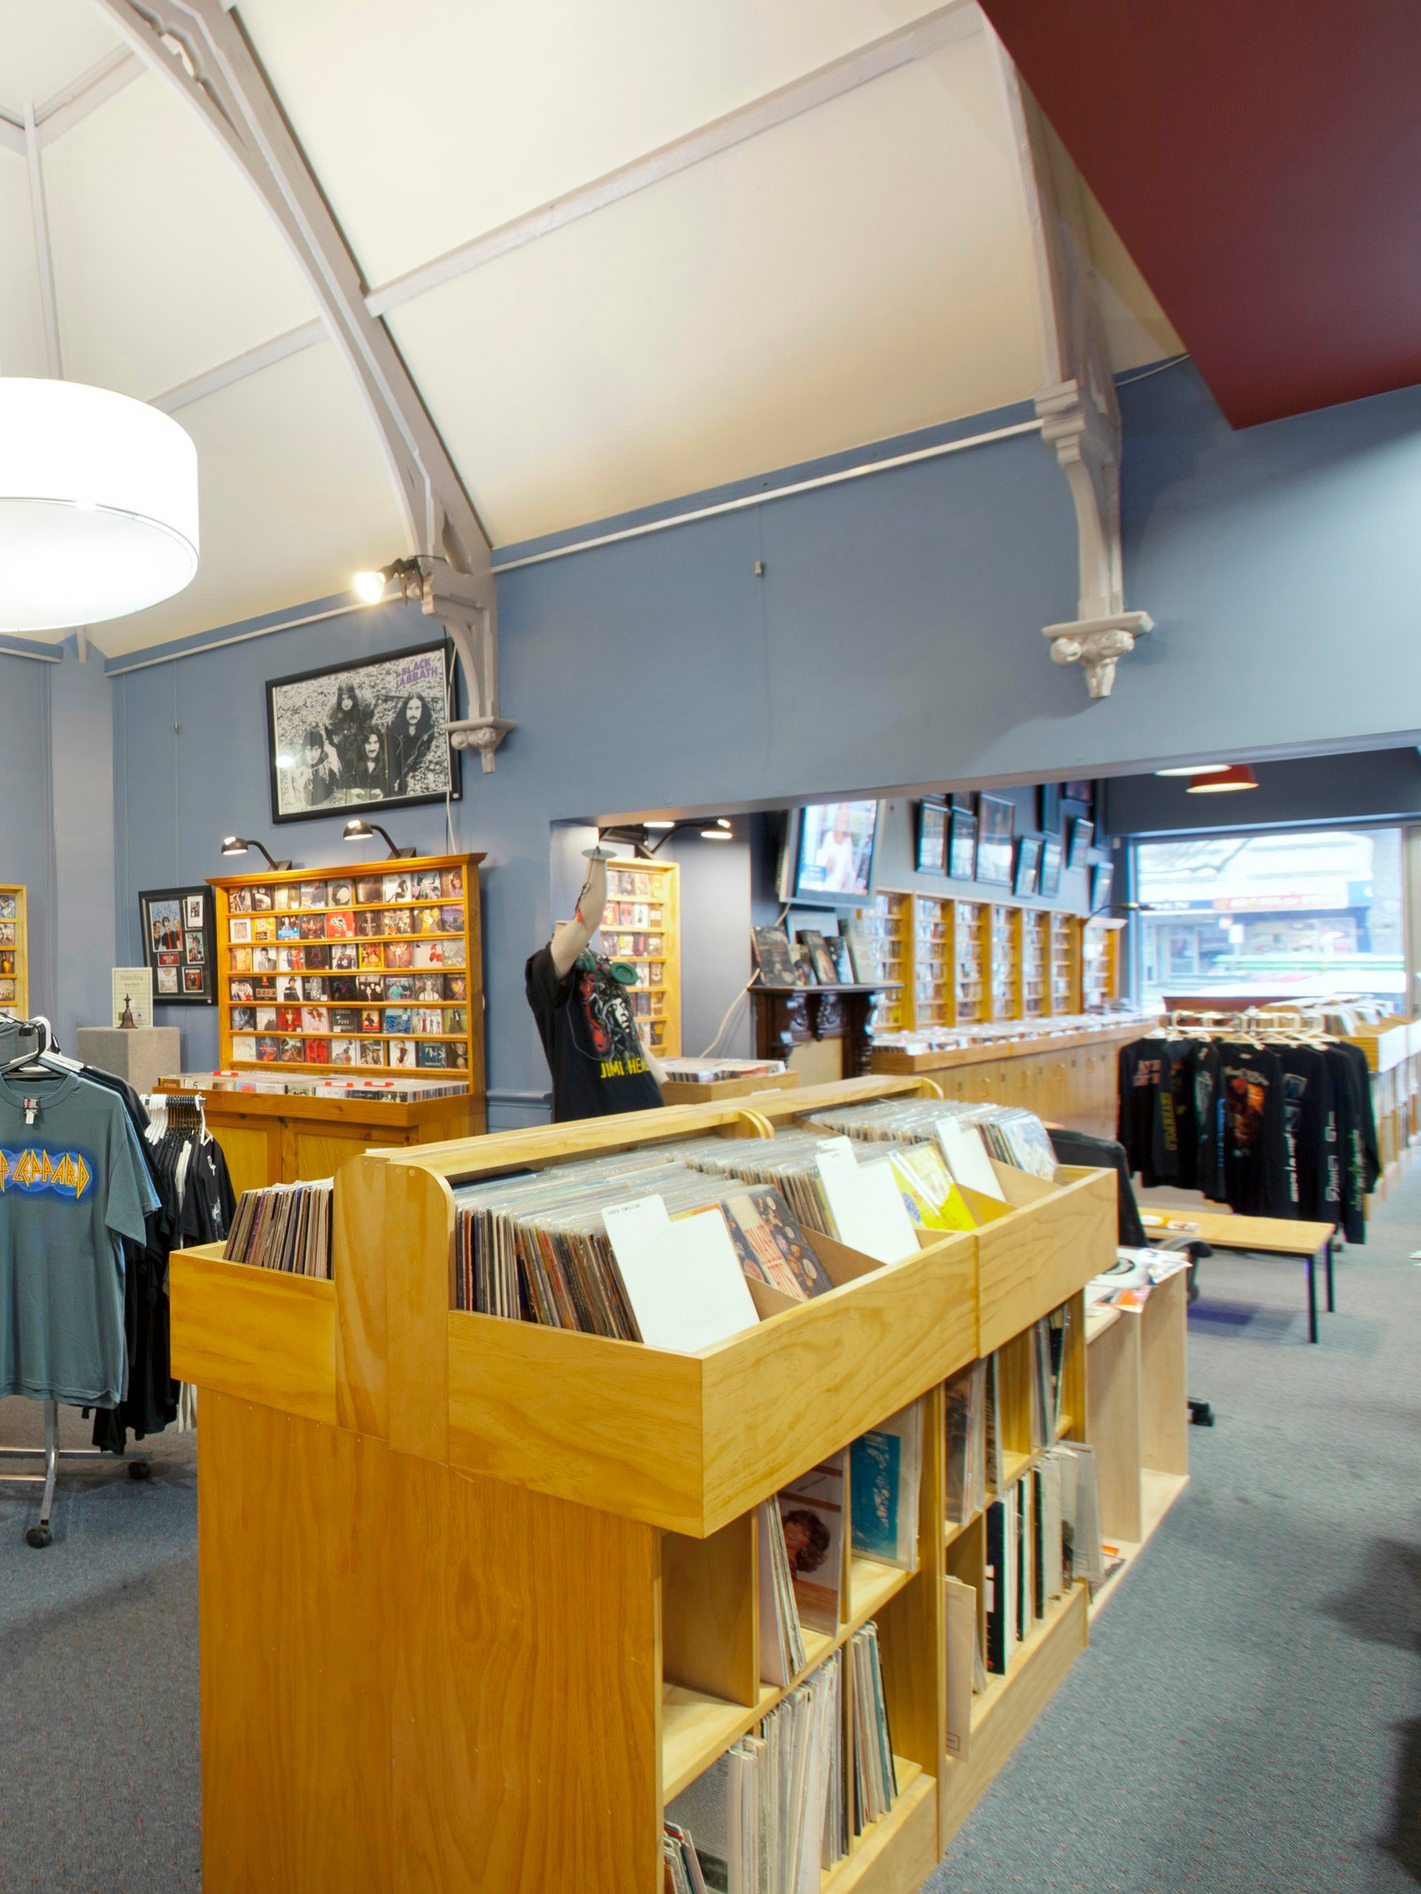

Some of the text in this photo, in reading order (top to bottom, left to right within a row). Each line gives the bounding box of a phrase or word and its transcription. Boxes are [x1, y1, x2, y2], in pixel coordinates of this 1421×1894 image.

[395, 666, 438, 689] SABBATH
[402, 657, 431, 677] BLACK
[600, 1060, 625, 1078] JIMI
[12, 1148, 91, 1200] LEPPARD
